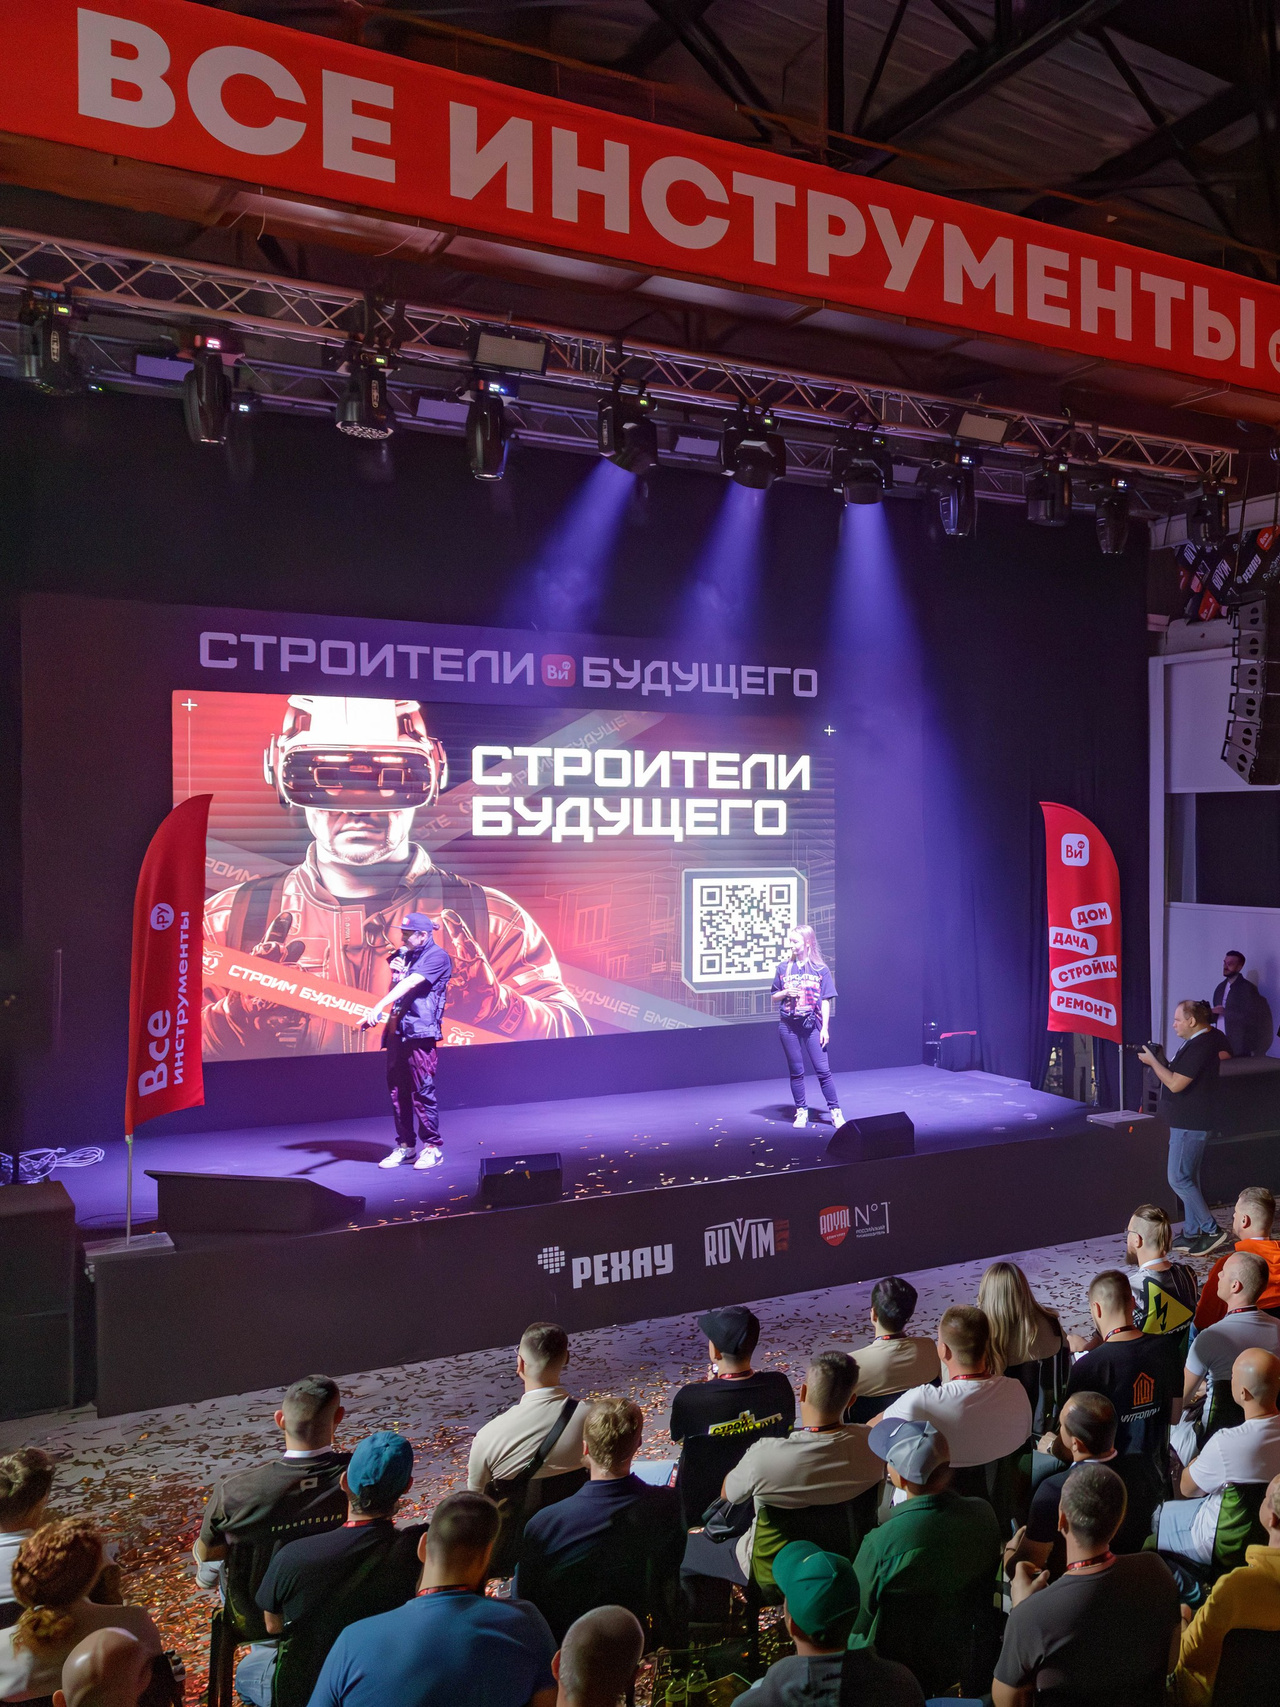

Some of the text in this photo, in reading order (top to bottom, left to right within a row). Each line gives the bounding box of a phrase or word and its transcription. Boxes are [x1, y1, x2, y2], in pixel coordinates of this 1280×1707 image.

[77, 8, 396, 183] ВСЕ
[449, 101, 1256, 369] ИНСТРУМЕНТЫ
[200, 631, 534, 685] СТРОИТЕЛИ
[583, 656, 818, 699] БУДУЩЕГО
[472, 745, 811, 791] СТРОИТЕЛИ
[471, 797, 787, 843] БУДУЩЕГО
[1066, 845, 1083, 859] Ви
[1077, 908, 1107, 925] ДОМ
[1053, 932, 1089, 950] ДАЧА
[228, 964, 297, 996] СТРОИМ
[1058, 959, 1117, 982] СТРОЙКА
[173, 911, 190, 1085] инструменты
[1056, 996, 1112, 1019] РЕМОНТ
[138, 1008, 171, 1097] Все
[704, 1218, 775, 1267] RUVIM
[571, 1243, 674, 1289] РЕХАУ
